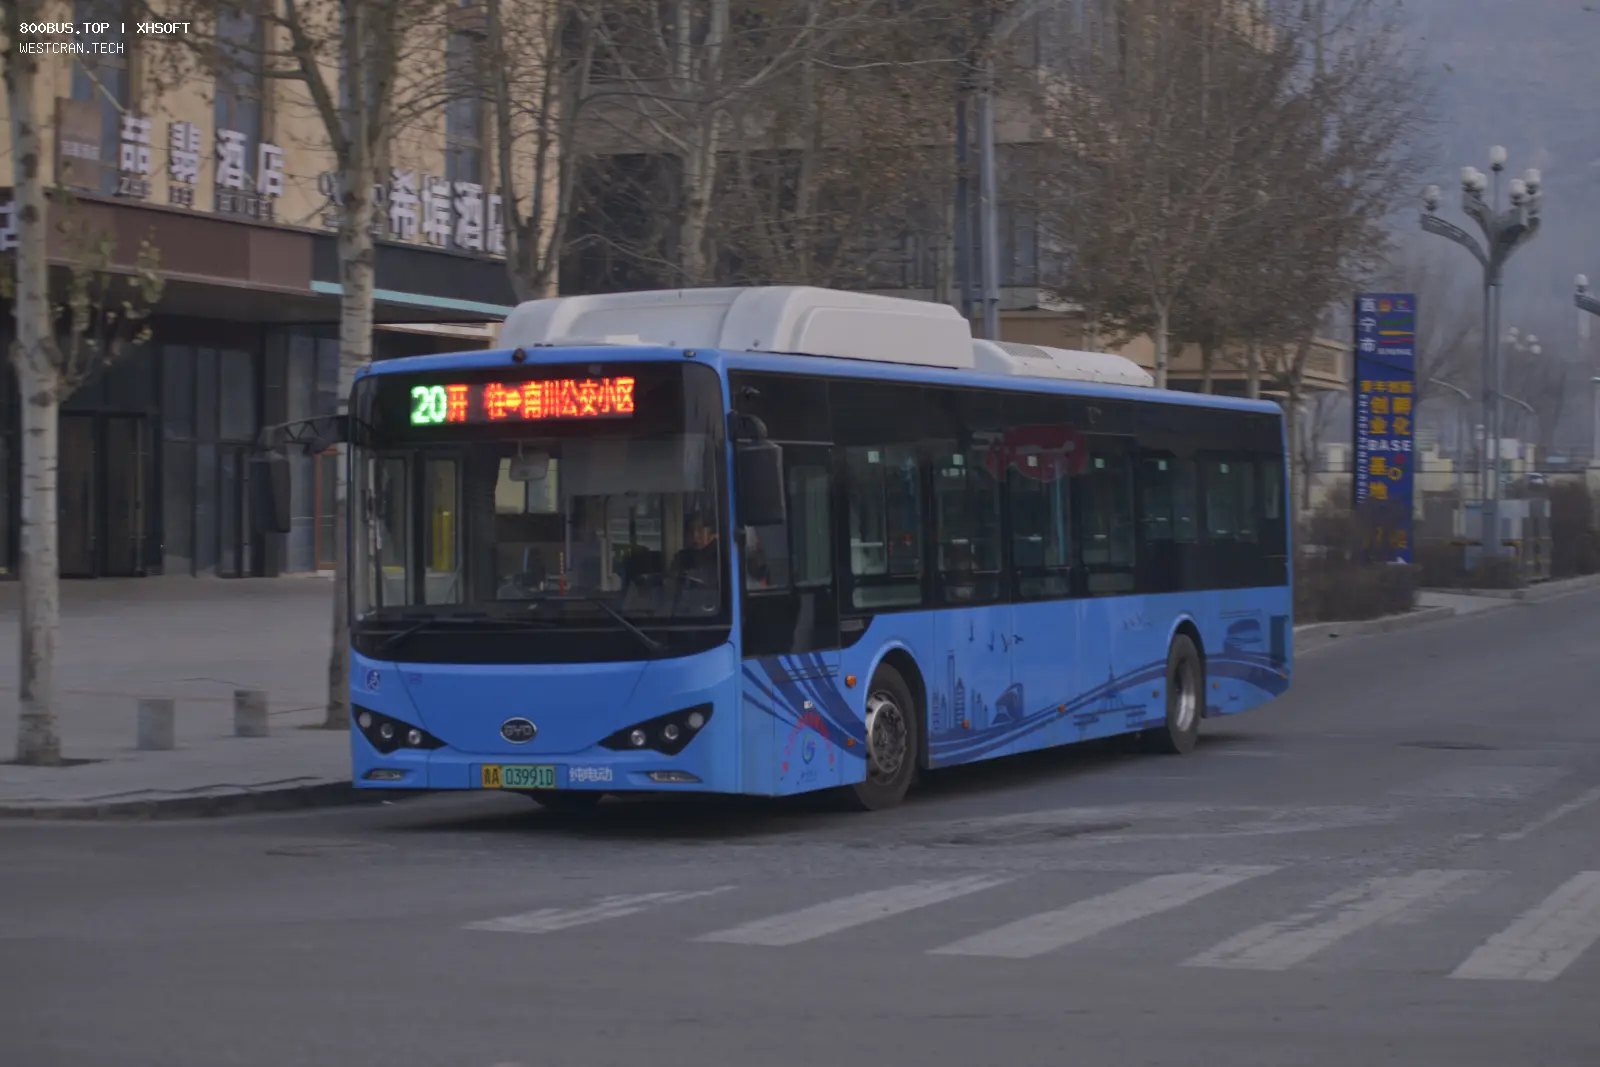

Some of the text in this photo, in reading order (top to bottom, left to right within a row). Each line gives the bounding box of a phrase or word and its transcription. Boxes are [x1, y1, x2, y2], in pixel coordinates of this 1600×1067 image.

[411, 385, 447, 425] 20
[523, 376, 635, 419] 南川公交小区
[1368, 439, 1412, 451] BASE
[503, 724, 533, 736] BYD
[569, 767, 613, 782] 纯电动
